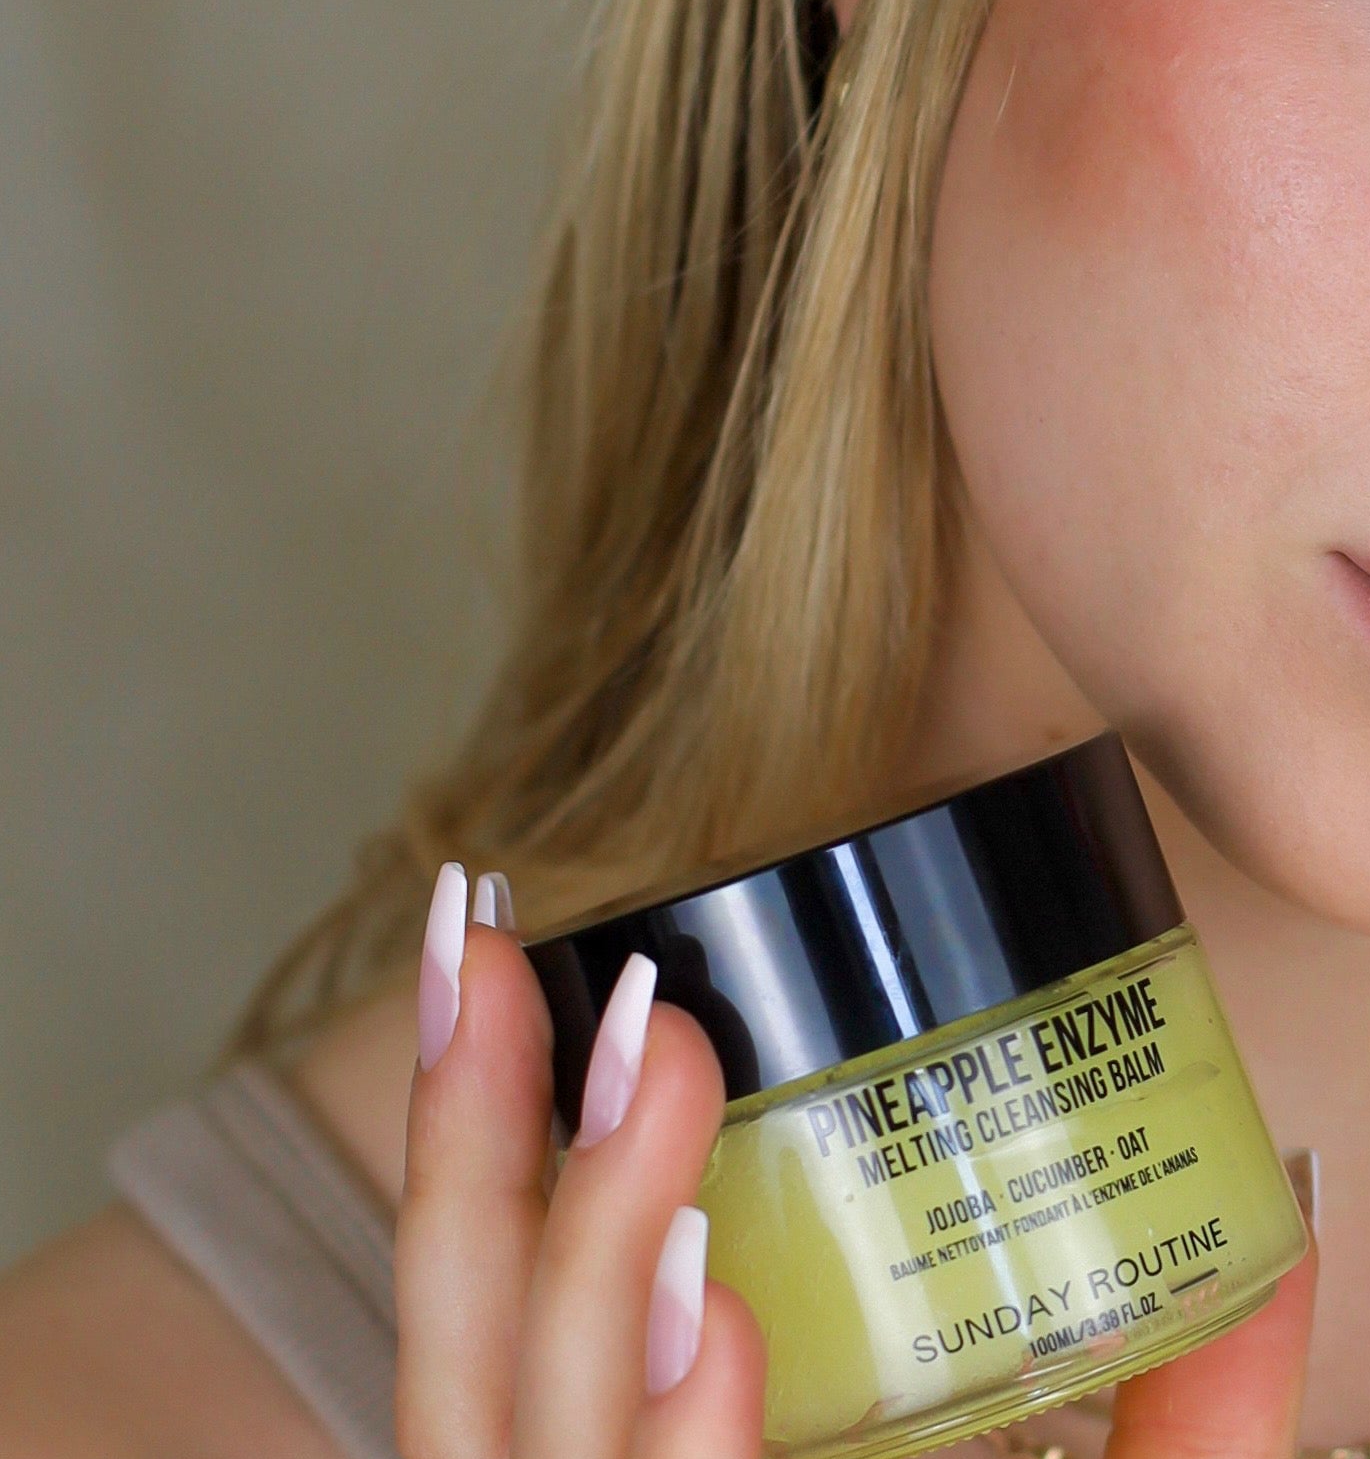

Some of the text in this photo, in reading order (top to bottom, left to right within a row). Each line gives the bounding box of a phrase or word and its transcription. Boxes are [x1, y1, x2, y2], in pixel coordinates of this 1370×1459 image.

[808, 977, 1166, 1158] PINEAPPLE ENZYME
[857, 1041, 1165, 1188] MELTING CLEANSING BALM
[889, 1146, 1199, 1281] BAUME NETTOYANT FONDANT À L'ENZYME DE L'ANANAS
[926, 1126, 1150, 1235] JOJOBA CUCUMBER OAT
[912, 1217, 1228, 1363] SUNDAY ROUTINE
